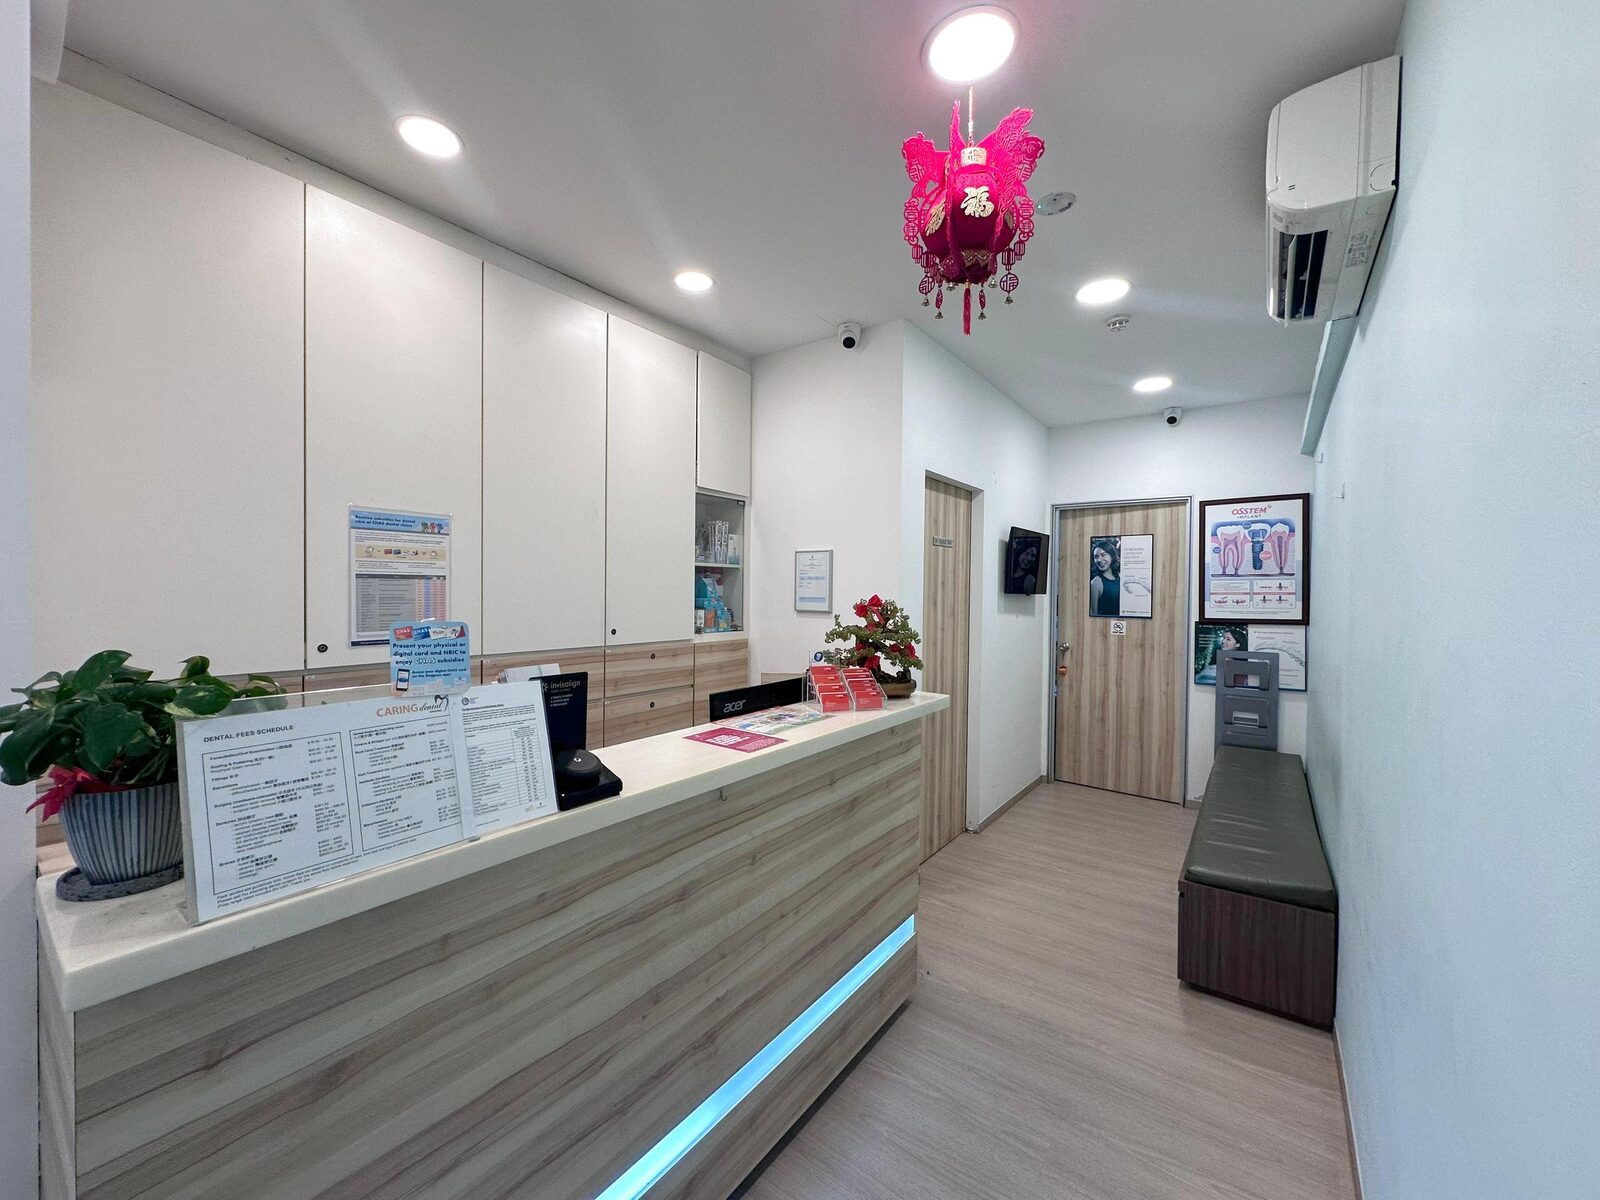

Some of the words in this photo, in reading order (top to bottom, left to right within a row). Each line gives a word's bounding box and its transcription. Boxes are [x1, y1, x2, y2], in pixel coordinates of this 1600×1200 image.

[960, 187, 994, 218] 福
[1232, 507, 1267, 515] OSSTEM
[433, 641, 458, 649] physical
[414, 657, 436, 665] CHAS
[550, 680, 581, 689] invisalign
[376, 704, 418, 717] CARING
[419, 701, 444, 711] dental
[723, 699, 746, 713] acer
[203, 734, 235, 743] DENTAL
[236, 730, 255, 738] FEES
[256, 725, 294, 735] SCHEDULE
